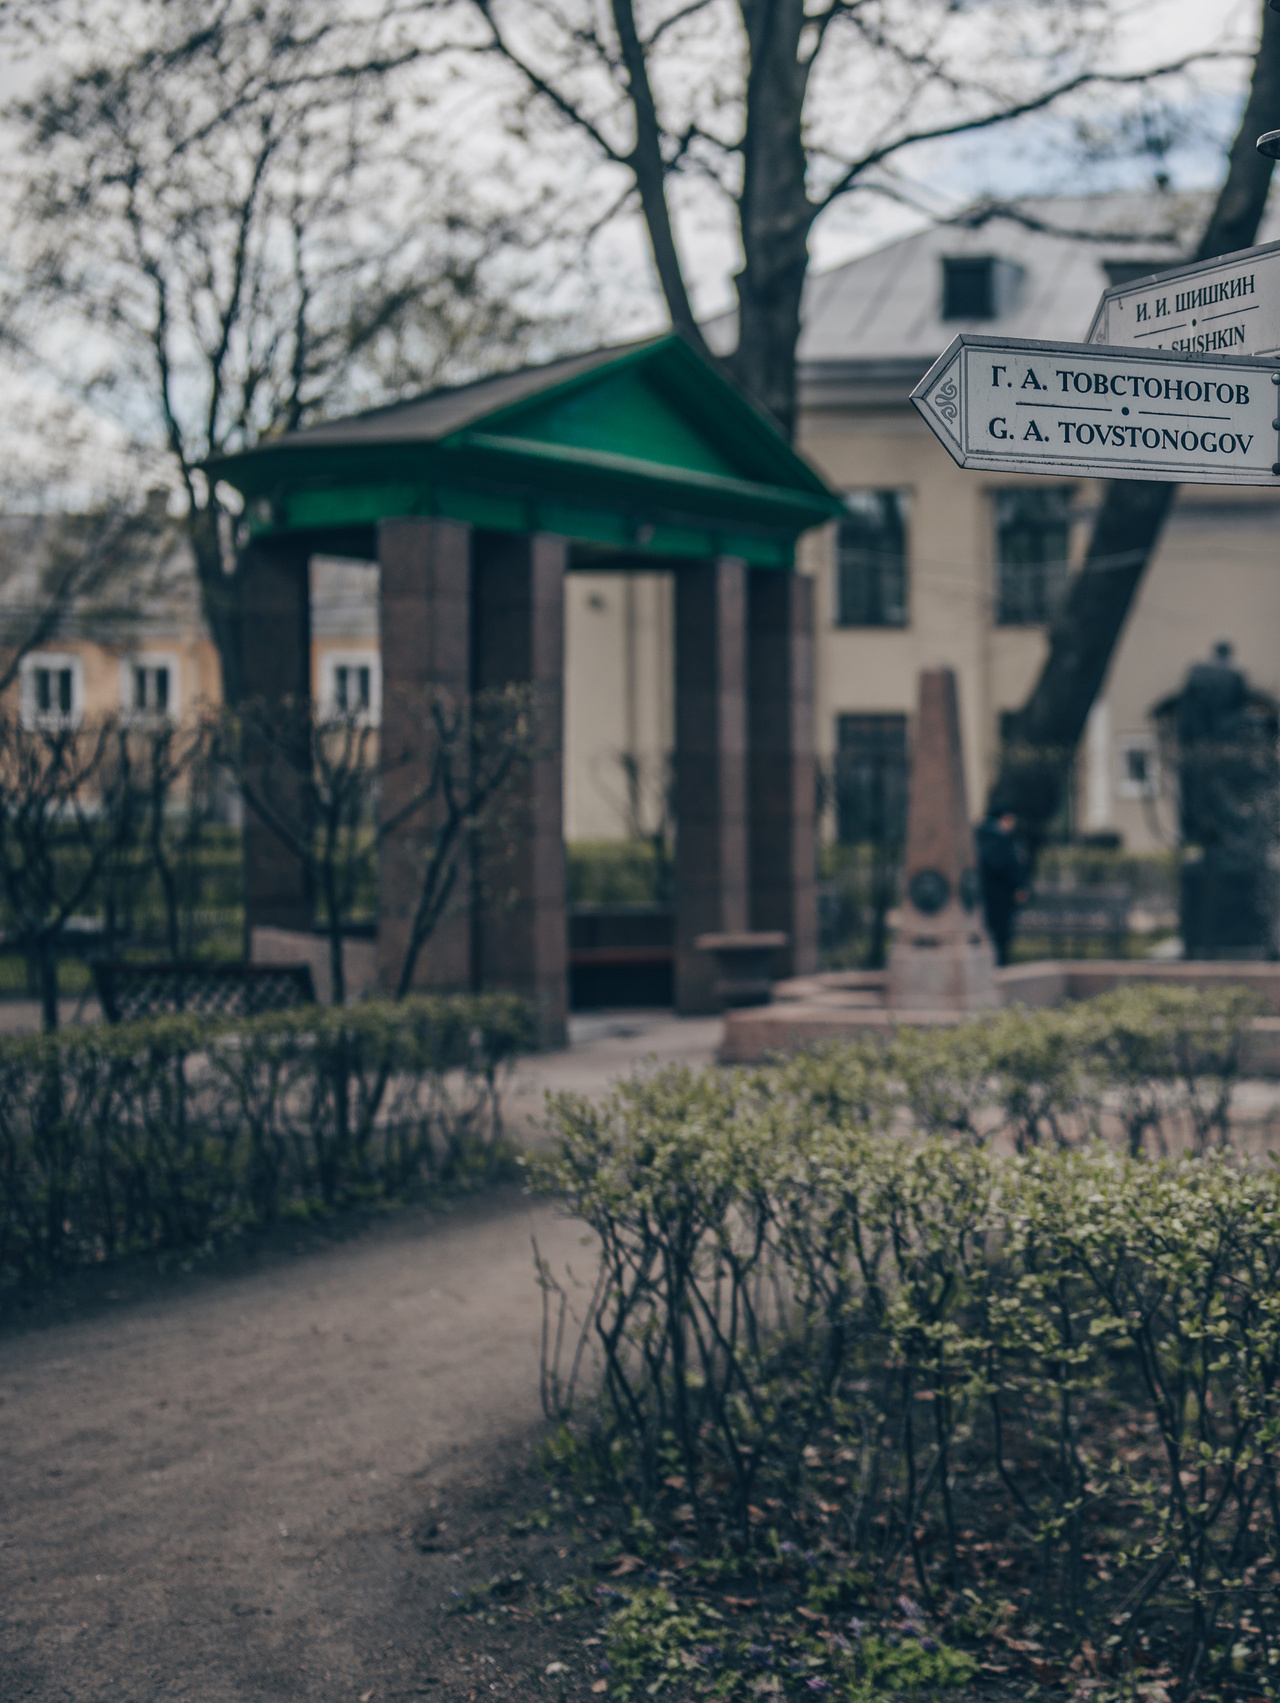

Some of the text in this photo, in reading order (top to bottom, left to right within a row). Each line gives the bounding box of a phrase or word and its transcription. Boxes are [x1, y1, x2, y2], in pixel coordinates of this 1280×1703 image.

[1136, 275, 1255, 323] И. И. ШИШКИН
[992, 365, 1250, 405] Г. А. ТОВСТОНОГОВ
[988, 417, 1254, 455] G. A. TOVSTONOGOV
